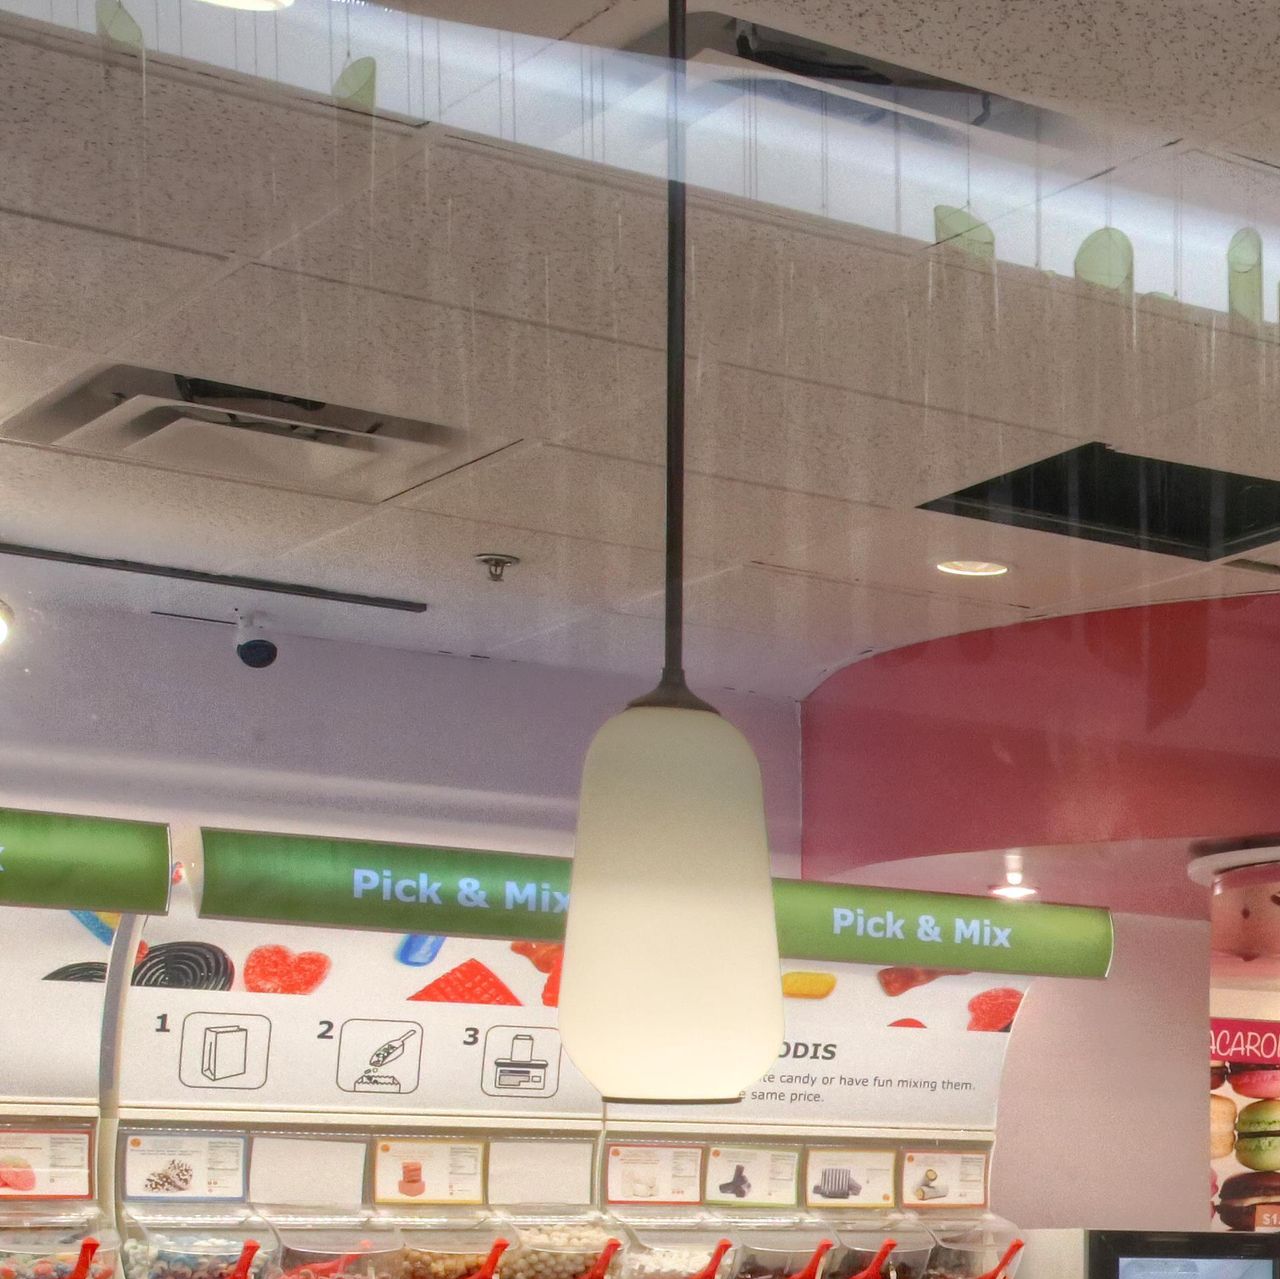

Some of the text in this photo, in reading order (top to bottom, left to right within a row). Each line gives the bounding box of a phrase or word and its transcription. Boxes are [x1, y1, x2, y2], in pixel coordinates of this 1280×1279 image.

[352, 868, 569, 914] Pick & Mix
[832, 907, 1012, 948] Pick & Mix
[155, 1014, 170, 1032] 1
[316, 1020, 334, 1039] 2
[463, 1027, 479, 1046] 3
[779, 1073, 817, 1086] candy
[822, 1076, 835, 1085] or
[839, 1074, 869, 1087] have
[873, 1076, 893, 1088] fun
[897, 1077, 937, 1091] mixing
[942, 1079, 976, 1091] them.
[751, 1091, 785, 1101] same
[790, 1090, 824, 1103] price.
